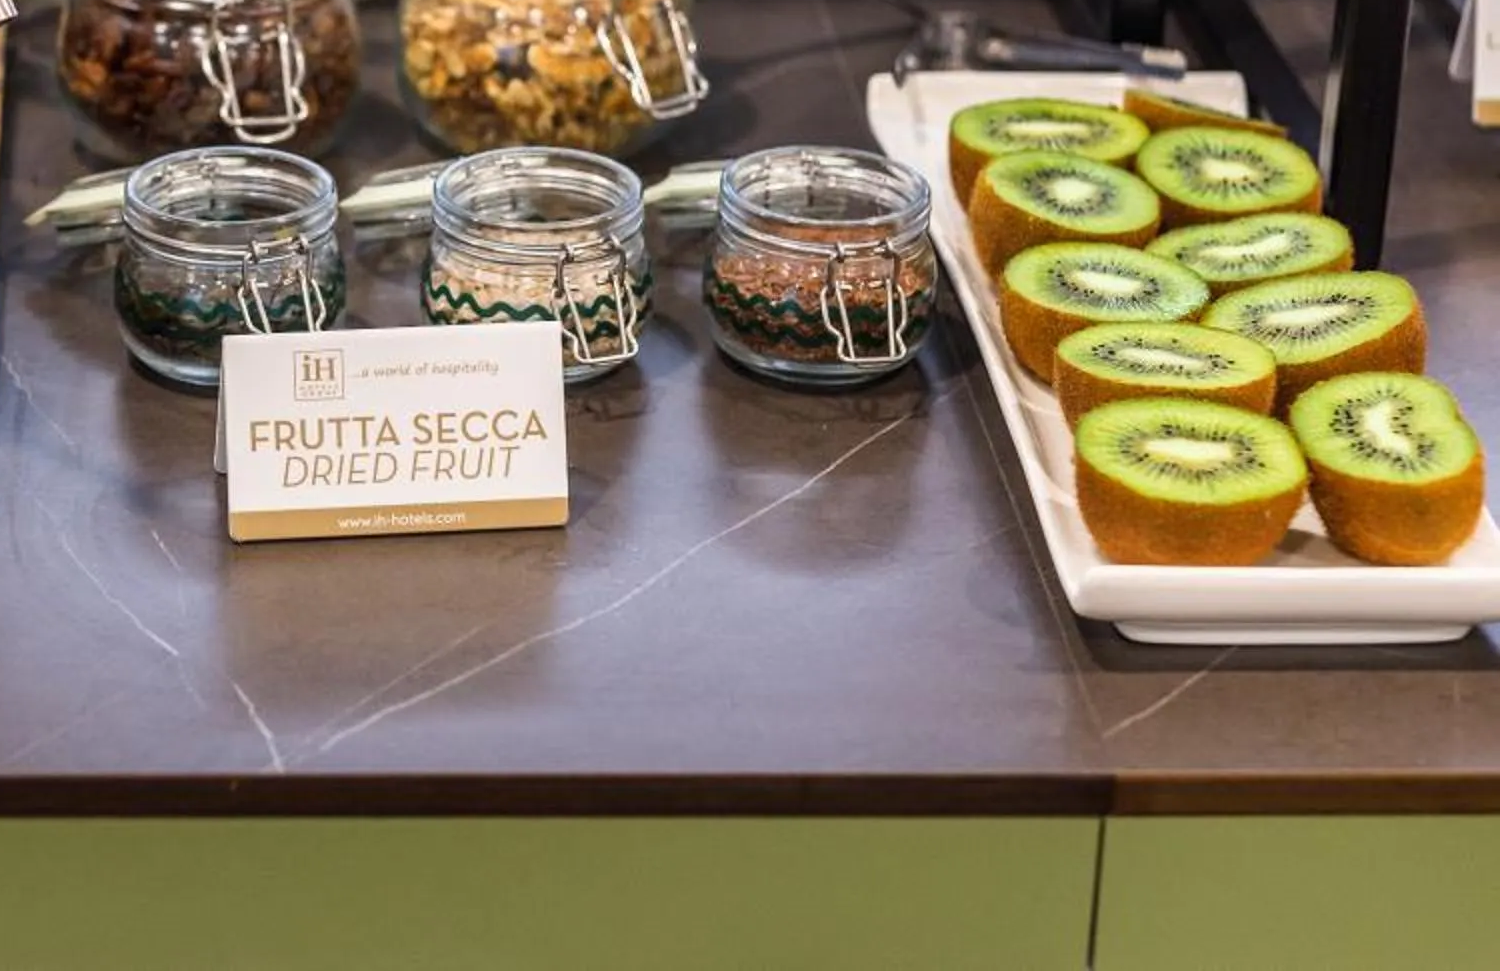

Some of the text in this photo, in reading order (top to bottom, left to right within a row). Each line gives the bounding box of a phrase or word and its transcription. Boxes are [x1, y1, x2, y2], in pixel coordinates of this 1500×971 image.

[301, 354, 337, 382] iH
[373, 363, 411, 378] world
[415, 361, 430, 376] of
[431, 359, 500, 378] hospitality
[249, 409, 548, 452] FRUTTA SECCA
[282, 445, 520, 488] DRIED FRUIT
[336, 512, 467, 529] www.ih-hotels.com
